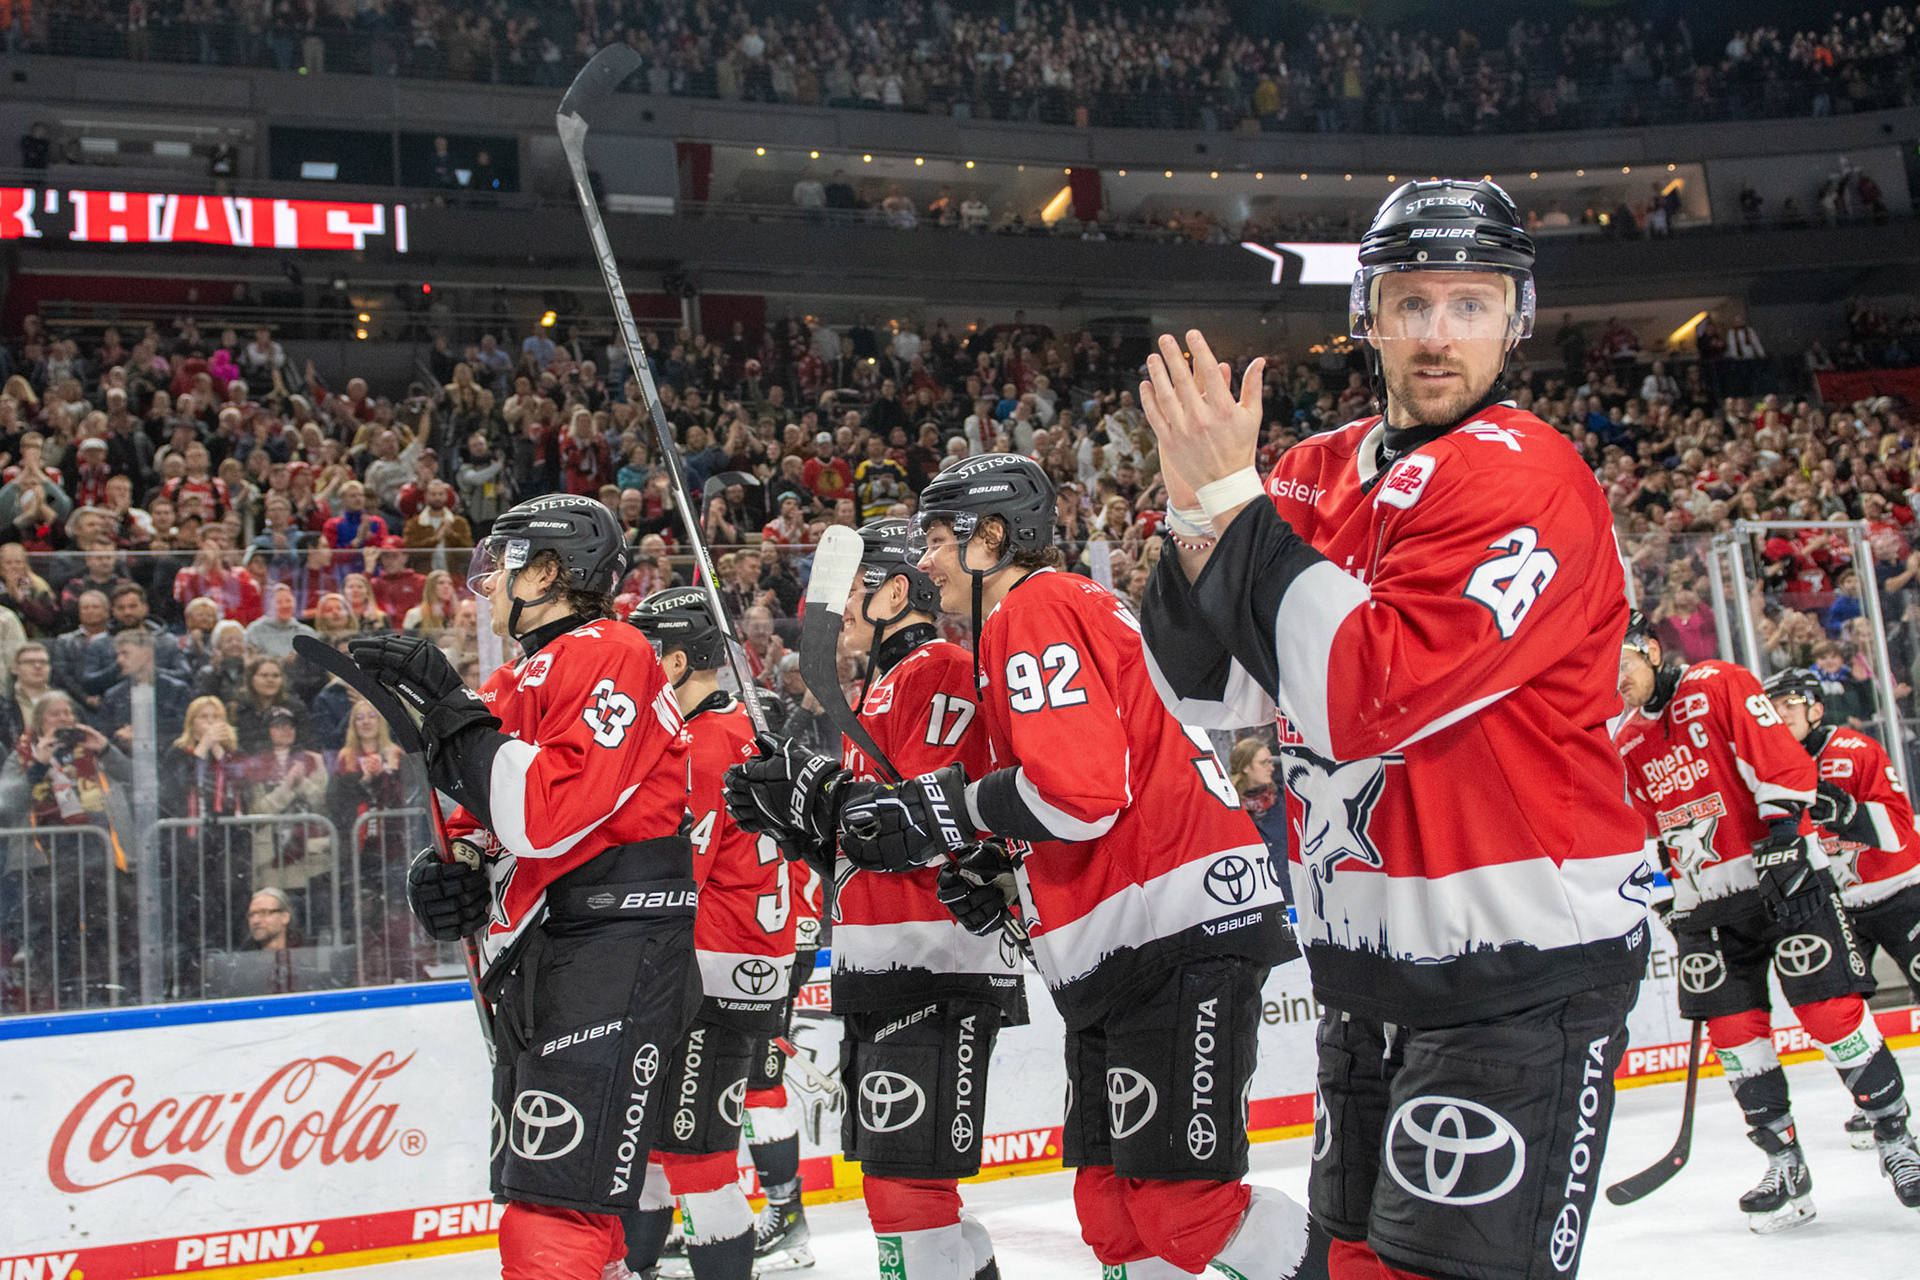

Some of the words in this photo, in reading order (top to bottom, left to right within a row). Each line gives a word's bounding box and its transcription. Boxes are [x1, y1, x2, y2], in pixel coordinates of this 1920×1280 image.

[1406, 197, 1486, 216] STETSON
[1410, 228, 1477, 239] BAUER
[958, 454, 1029, 480] STETSON
[968, 484, 1009, 495] BAUER
[530, 498, 602, 513] STETSON
[529, 520, 568, 530] BAUER
[1463, 525, 1560, 641] 26
[651, 592, 705, 615] STETSON
[657, 621, 689, 629] BAUER
[1005, 641, 1090, 715] 92
[398, 683, 426, 706] BAUER
[743, 681, 765, 725] BAUER
[581, 677, 637, 749] 33
[923, 692, 977, 747] 17
[1688, 721, 1709, 749] C
[918, 772, 967, 852] BAUER
[684, 808, 718, 856] 4
[458, 845, 476, 861] 33
[1753, 848, 1800, 869] UER
[755, 832, 791, 935] 3
[620, 890, 699, 910] BAUE
[1217, 912, 1263, 935] BAUER
[996, 977, 1018, 987] BAUER
[727, 1002, 772, 1012] BAUER
[874, 1003, 939, 1044] BAUER
[541, 1020, 623, 1057] BAUER
[1191, 997, 1219, 1108] TOYOTA
[1774, 1030, 1814, 1053] PEN
[679, 1029, 706, 1107] TOYOTA
[956, 1015, 977, 1111] TOYOTA
[47, 1047, 419, 1194] Coca-Cola
[1565, 1035, 1610, 1198] TOYOTA
[610, 1089, 649, 1196] TOYOTA
